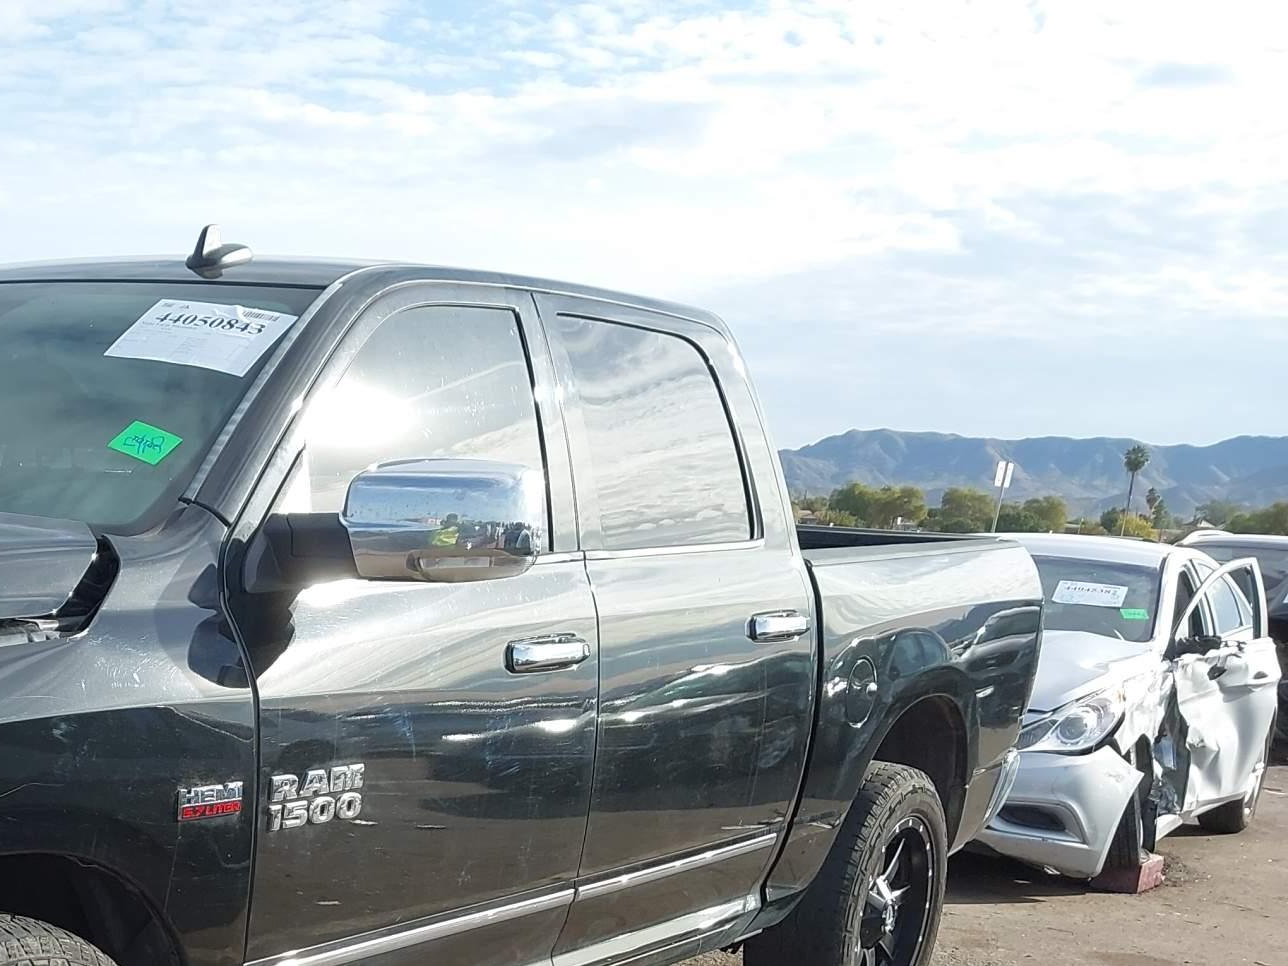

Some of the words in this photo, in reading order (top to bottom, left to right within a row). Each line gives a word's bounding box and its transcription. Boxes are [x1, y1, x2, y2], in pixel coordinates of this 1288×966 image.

[155, 312, 266, 335] 44050843
[178, 781, 243, 806] HEMI
[270, 763, 365, 802] RAM
[268, 791, 362, 832] 1500
